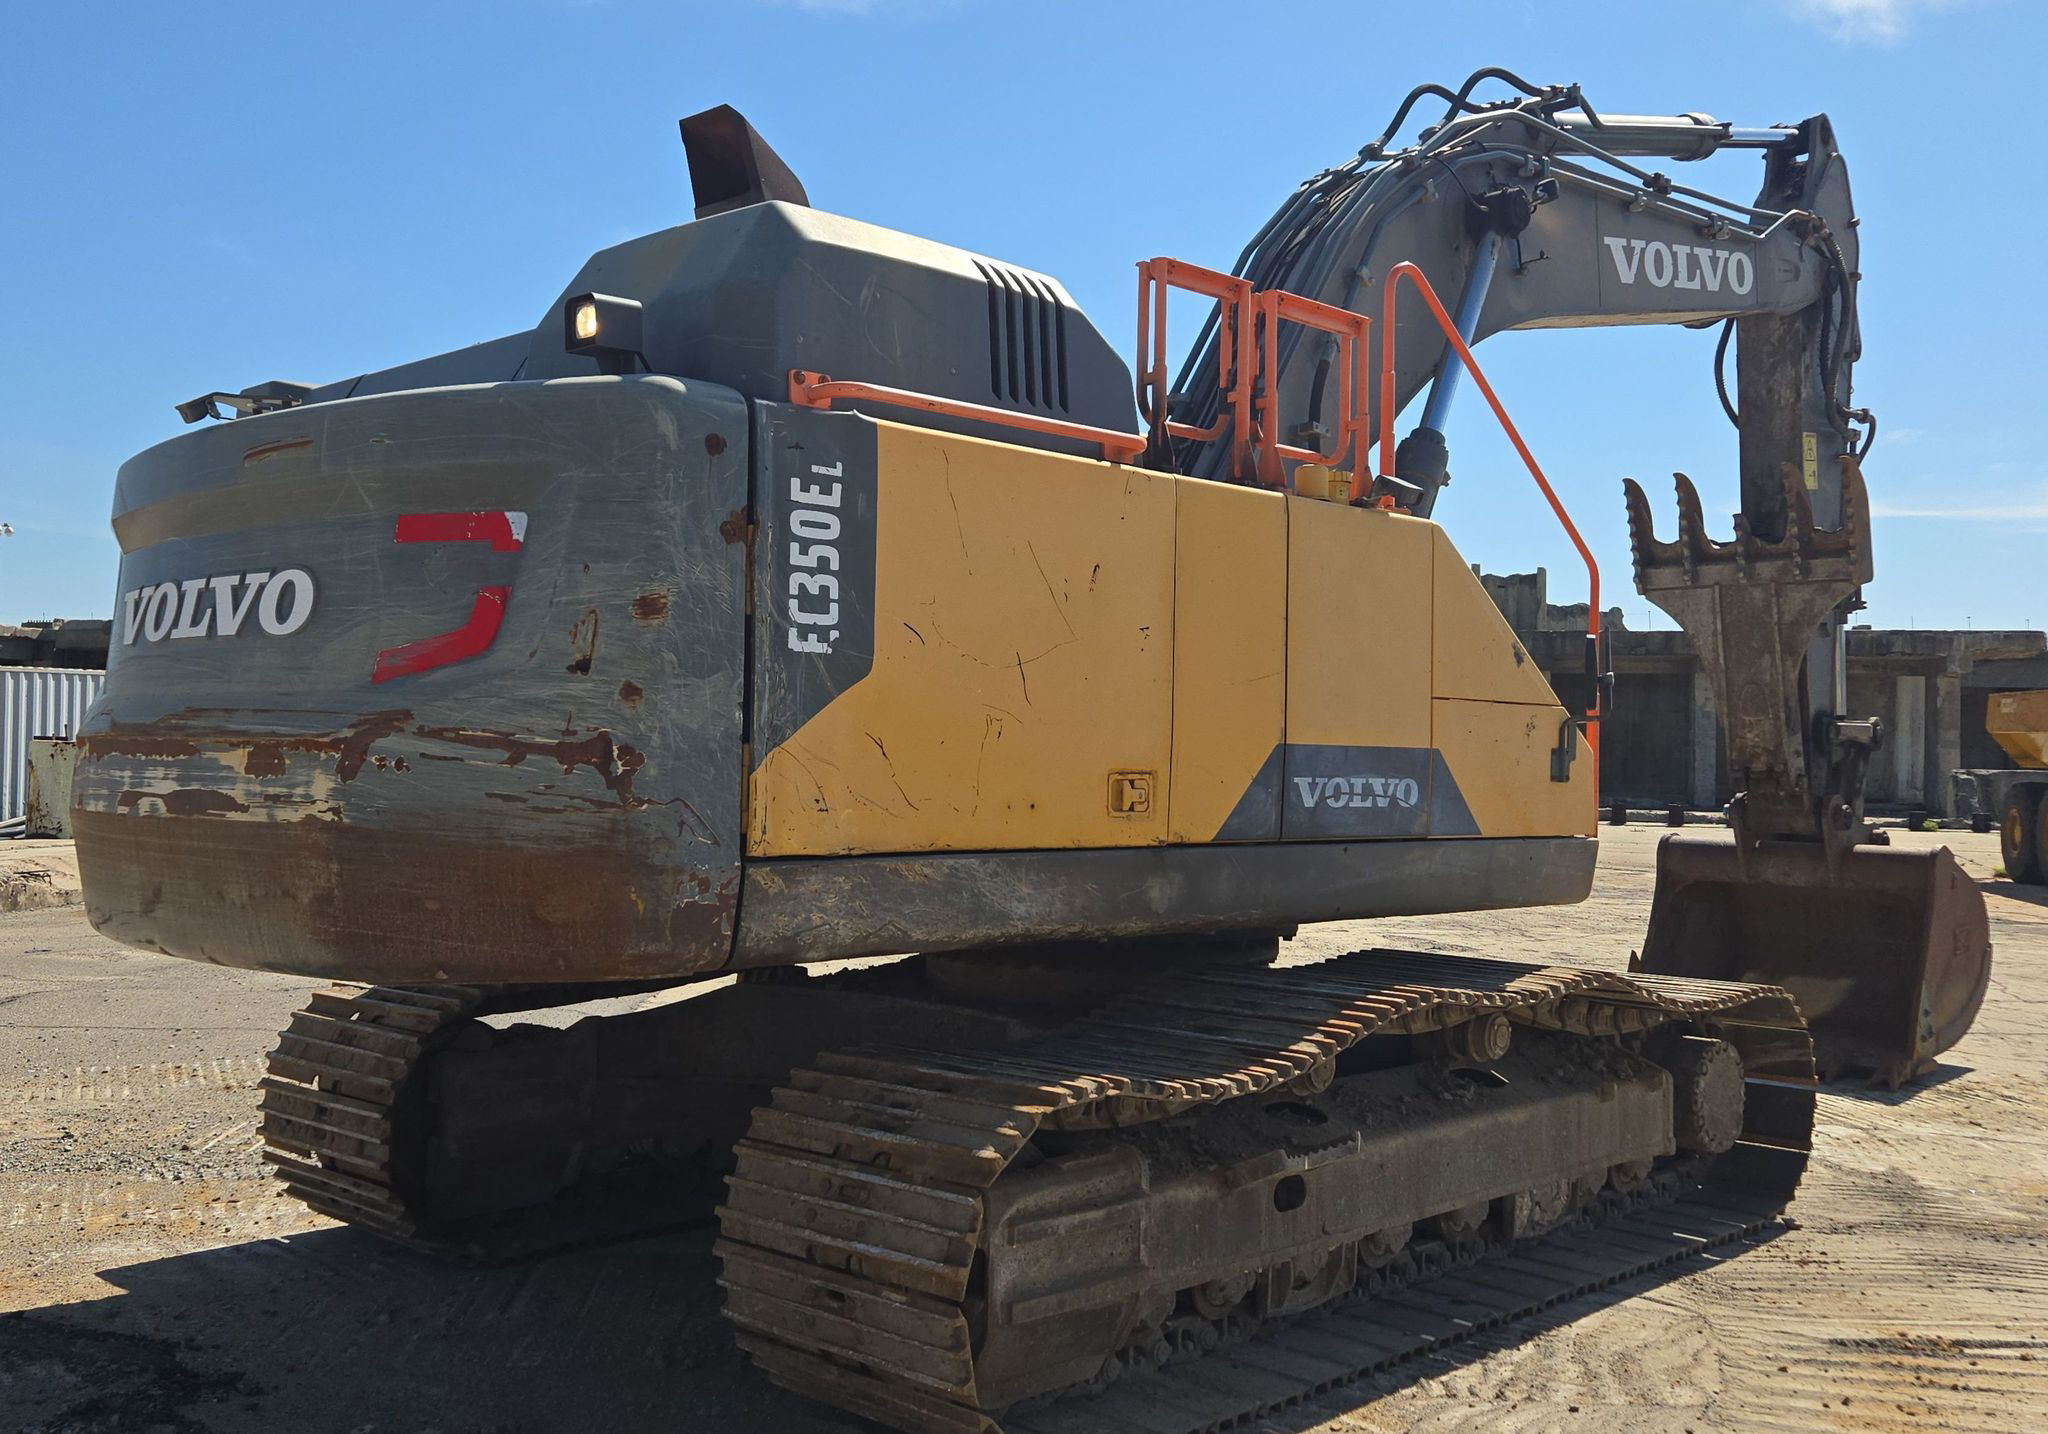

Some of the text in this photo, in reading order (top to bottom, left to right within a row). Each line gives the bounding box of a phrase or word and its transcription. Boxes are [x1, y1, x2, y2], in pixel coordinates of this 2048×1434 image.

[1603, 236, 1754, 295] VOLVO
[788, 461, 843, 655] EC350EL
[123, 568, 314, 646] VOLVO
[1293, 776, 1419, 808] VOLVO
